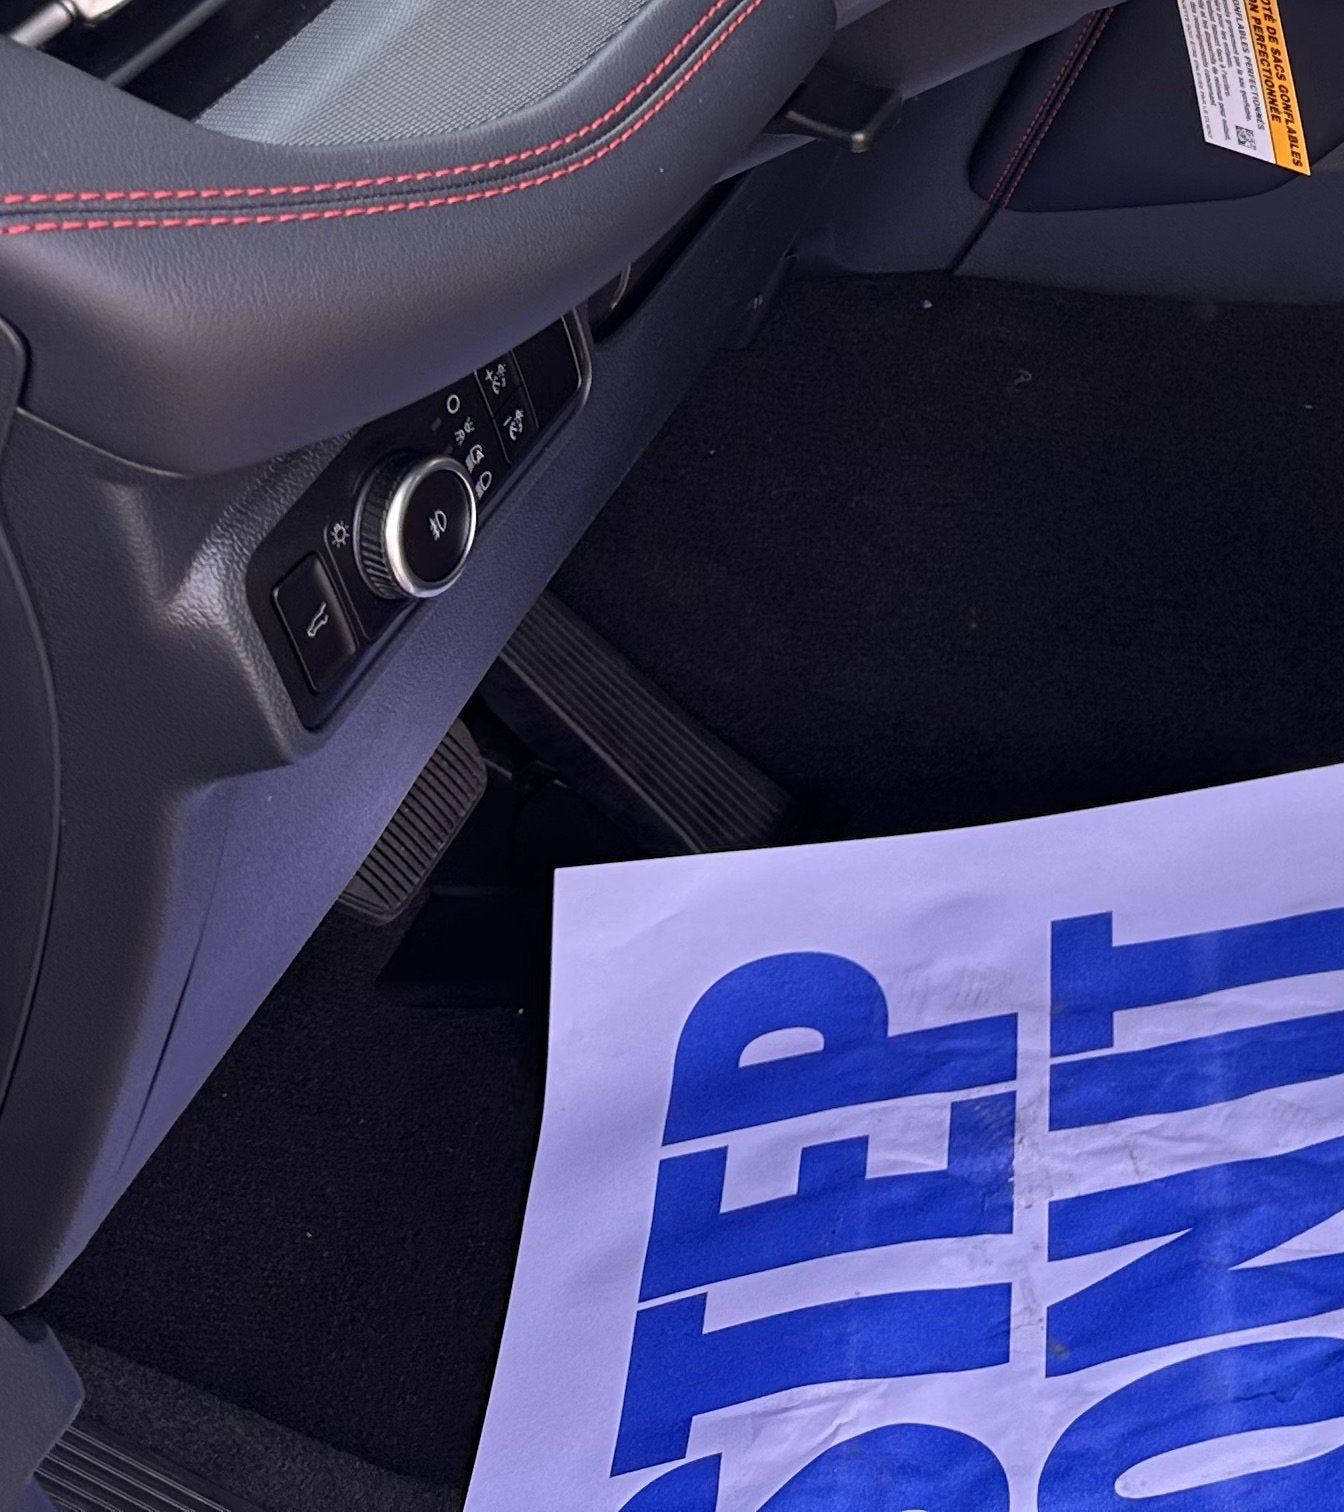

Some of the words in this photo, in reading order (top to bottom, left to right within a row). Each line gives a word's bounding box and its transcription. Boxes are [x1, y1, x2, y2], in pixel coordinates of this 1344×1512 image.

[1265, 26, 1278, 44] DE
[1270, 48, 1285, 79] SACS
[1251, 16, 1282, 122] PERFECTIONNÉE
[1276, 82, 1302, 167] GONFLABLES
